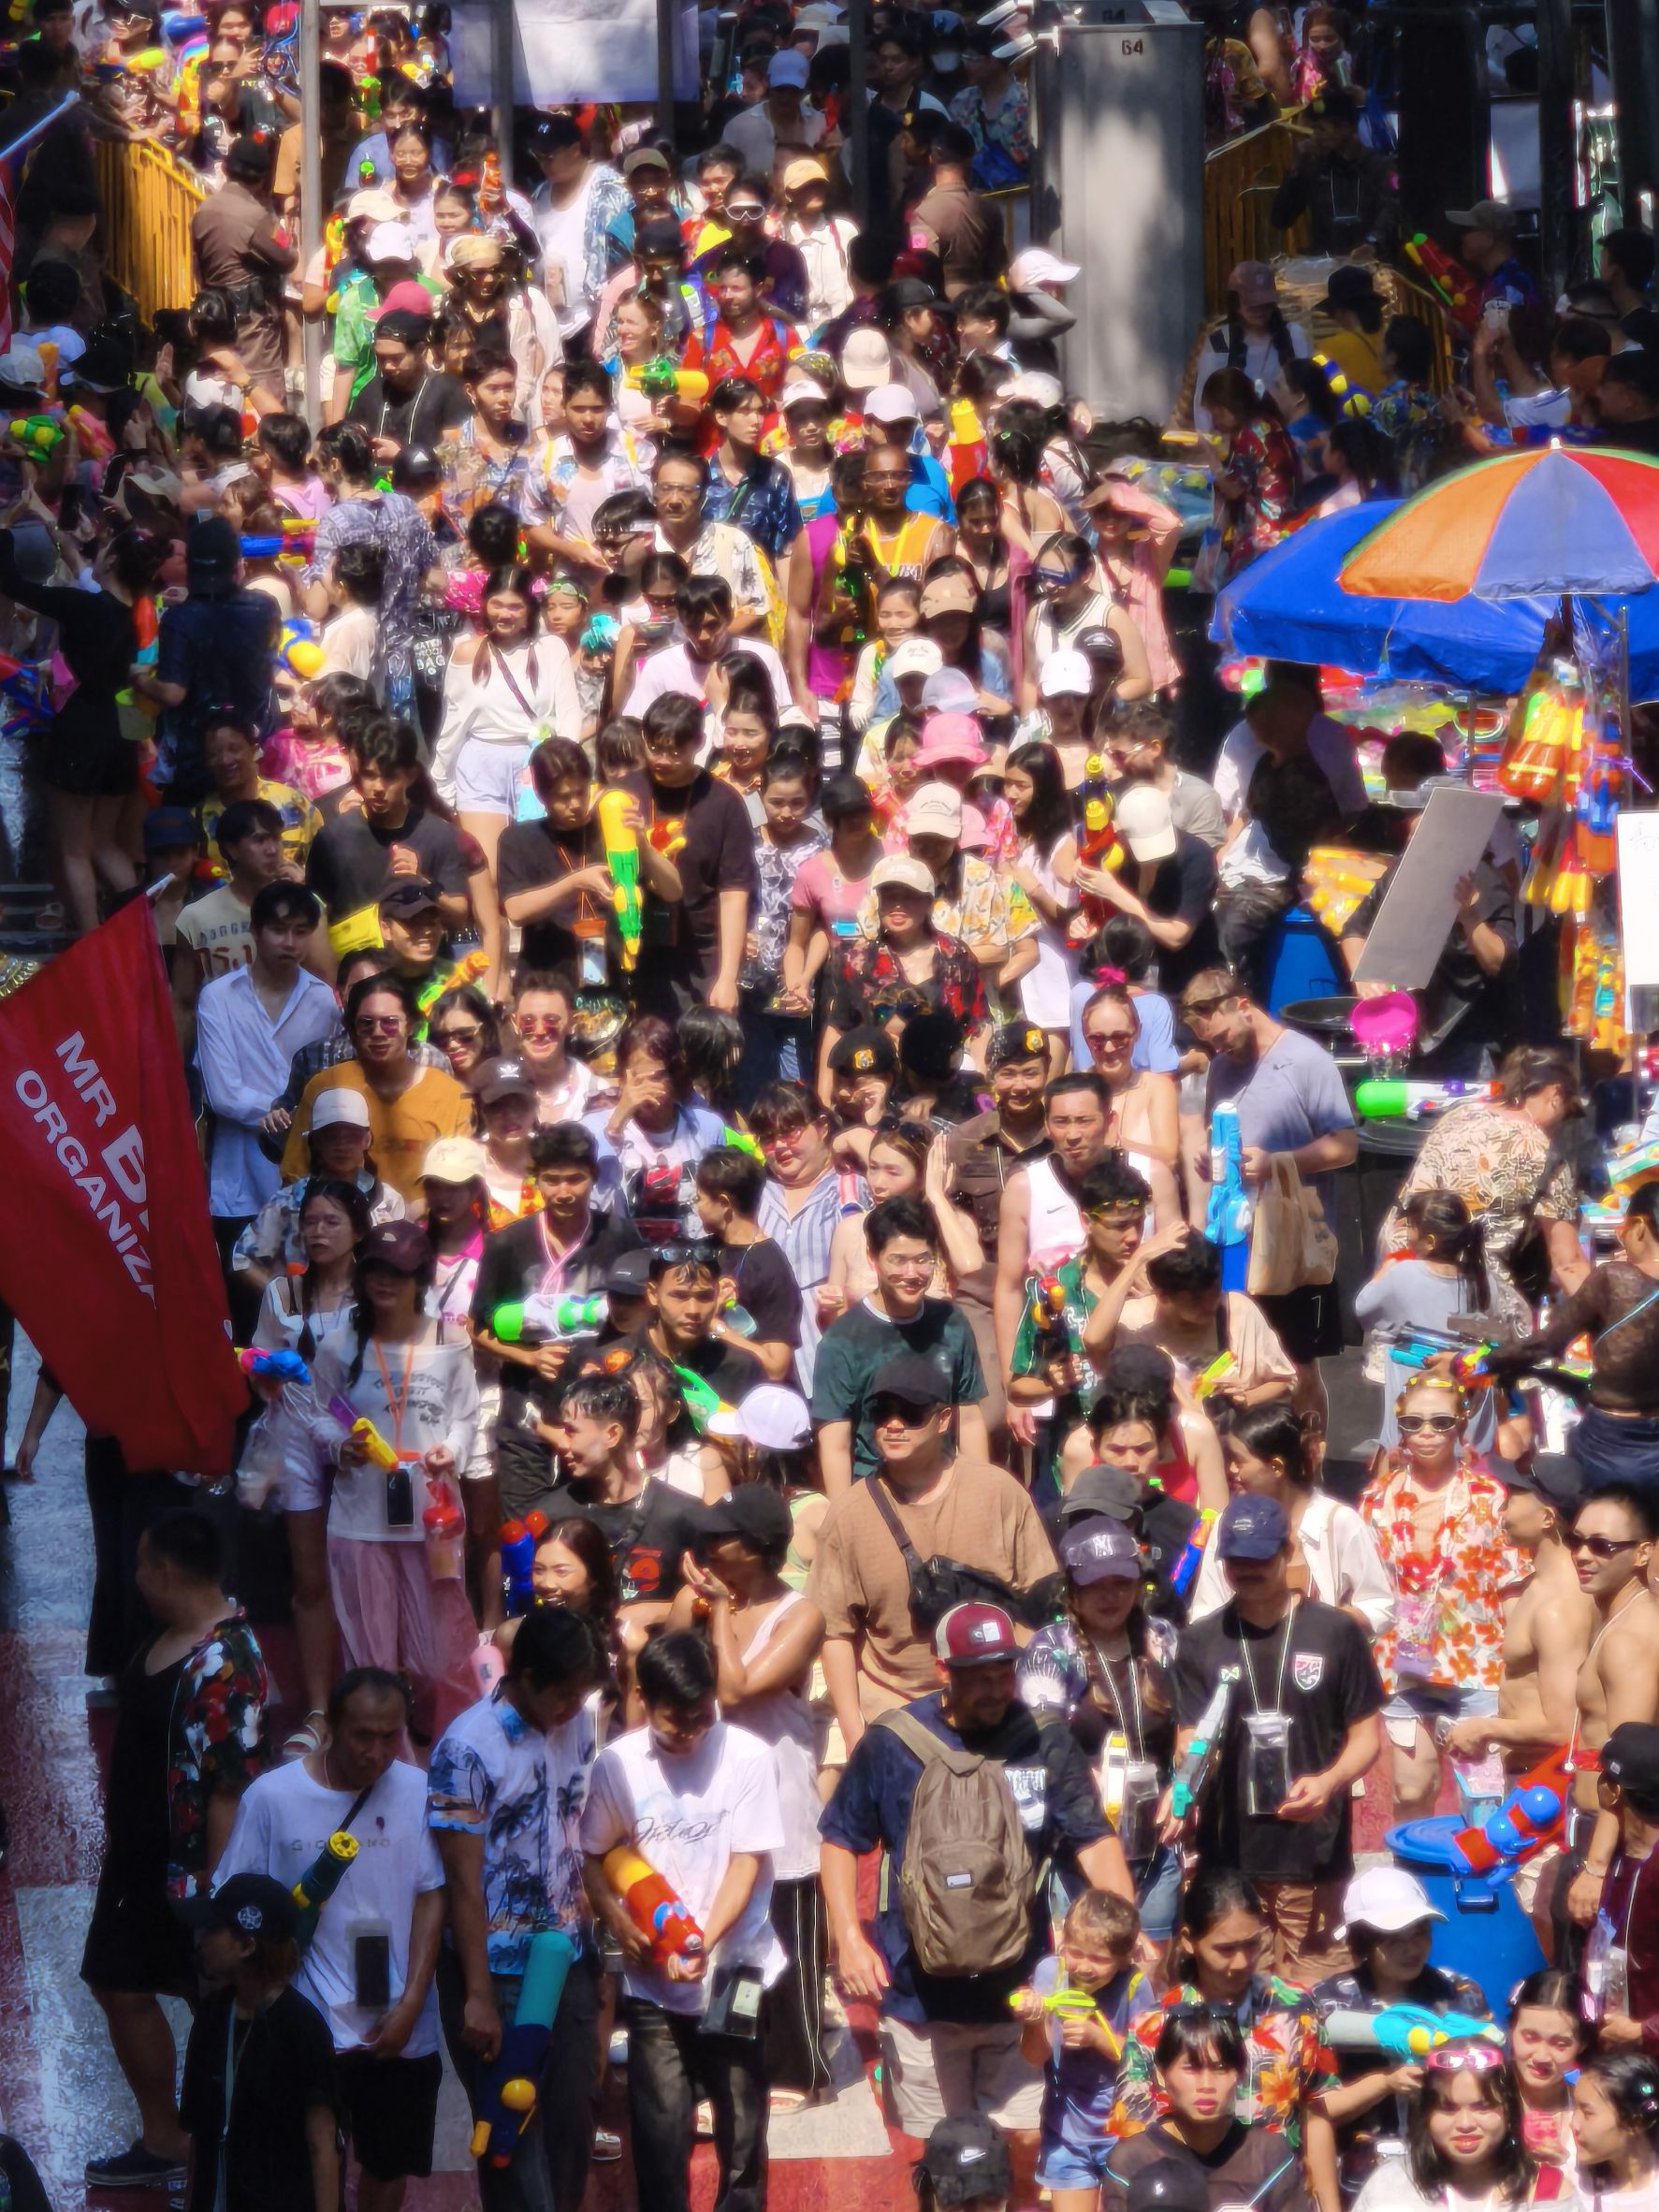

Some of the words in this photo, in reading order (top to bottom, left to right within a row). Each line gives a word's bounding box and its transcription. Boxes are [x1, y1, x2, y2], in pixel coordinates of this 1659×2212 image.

[1122, 38, 1142, 55] 64
[55, 1030, 117, 1128] MR
[15, 1070, 157, 1311] ORGANIZ
[291, 1838, 391, 1852] GIONO
